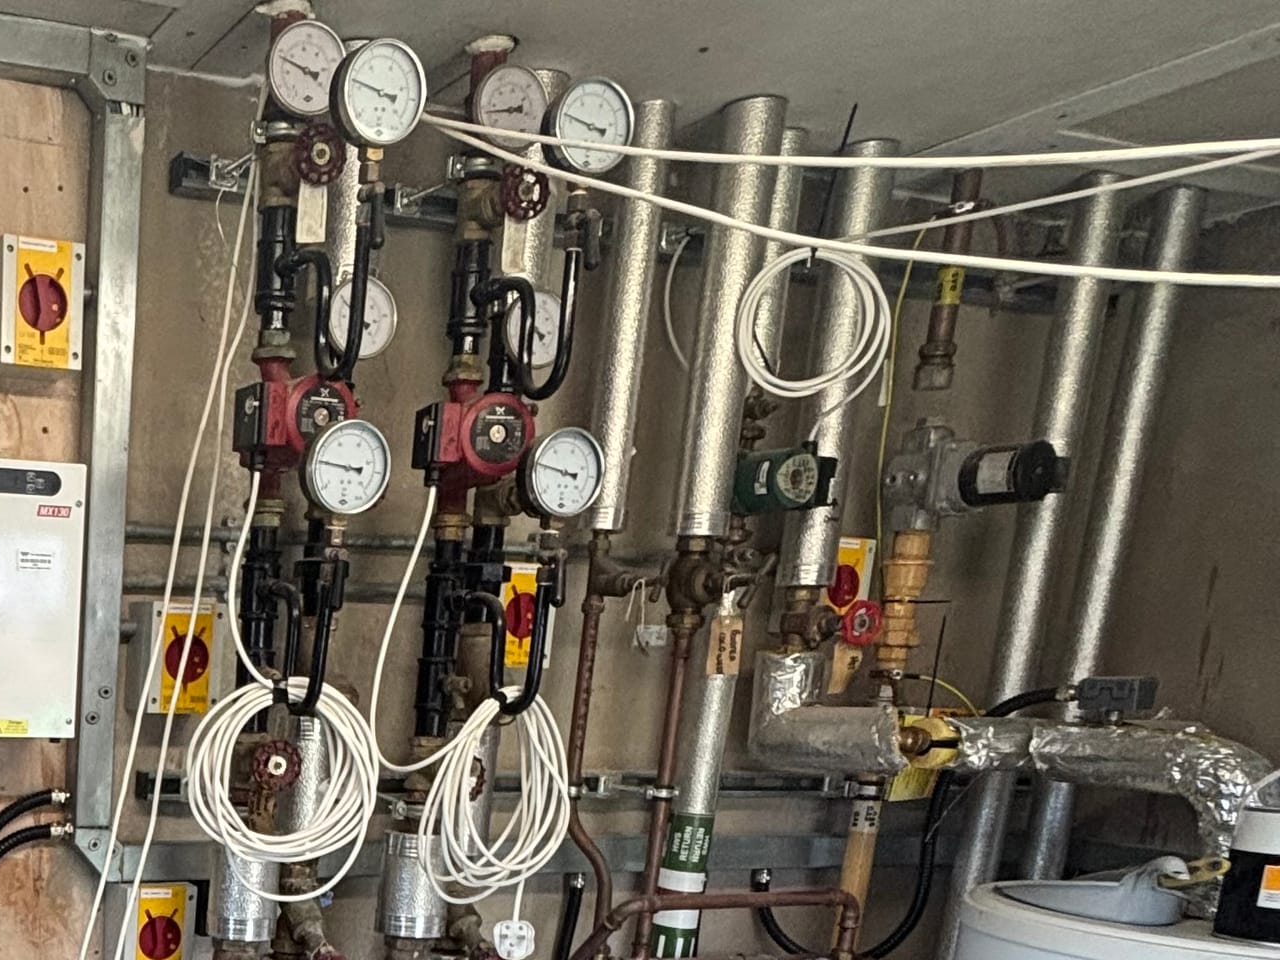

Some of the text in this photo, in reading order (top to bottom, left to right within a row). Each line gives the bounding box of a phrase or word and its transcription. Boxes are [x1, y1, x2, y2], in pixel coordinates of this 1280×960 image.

[672, 832, 682, 852] HWS
[679, 825, 693, 862] RETURN
[691, 827, 706, 863] RETURN
